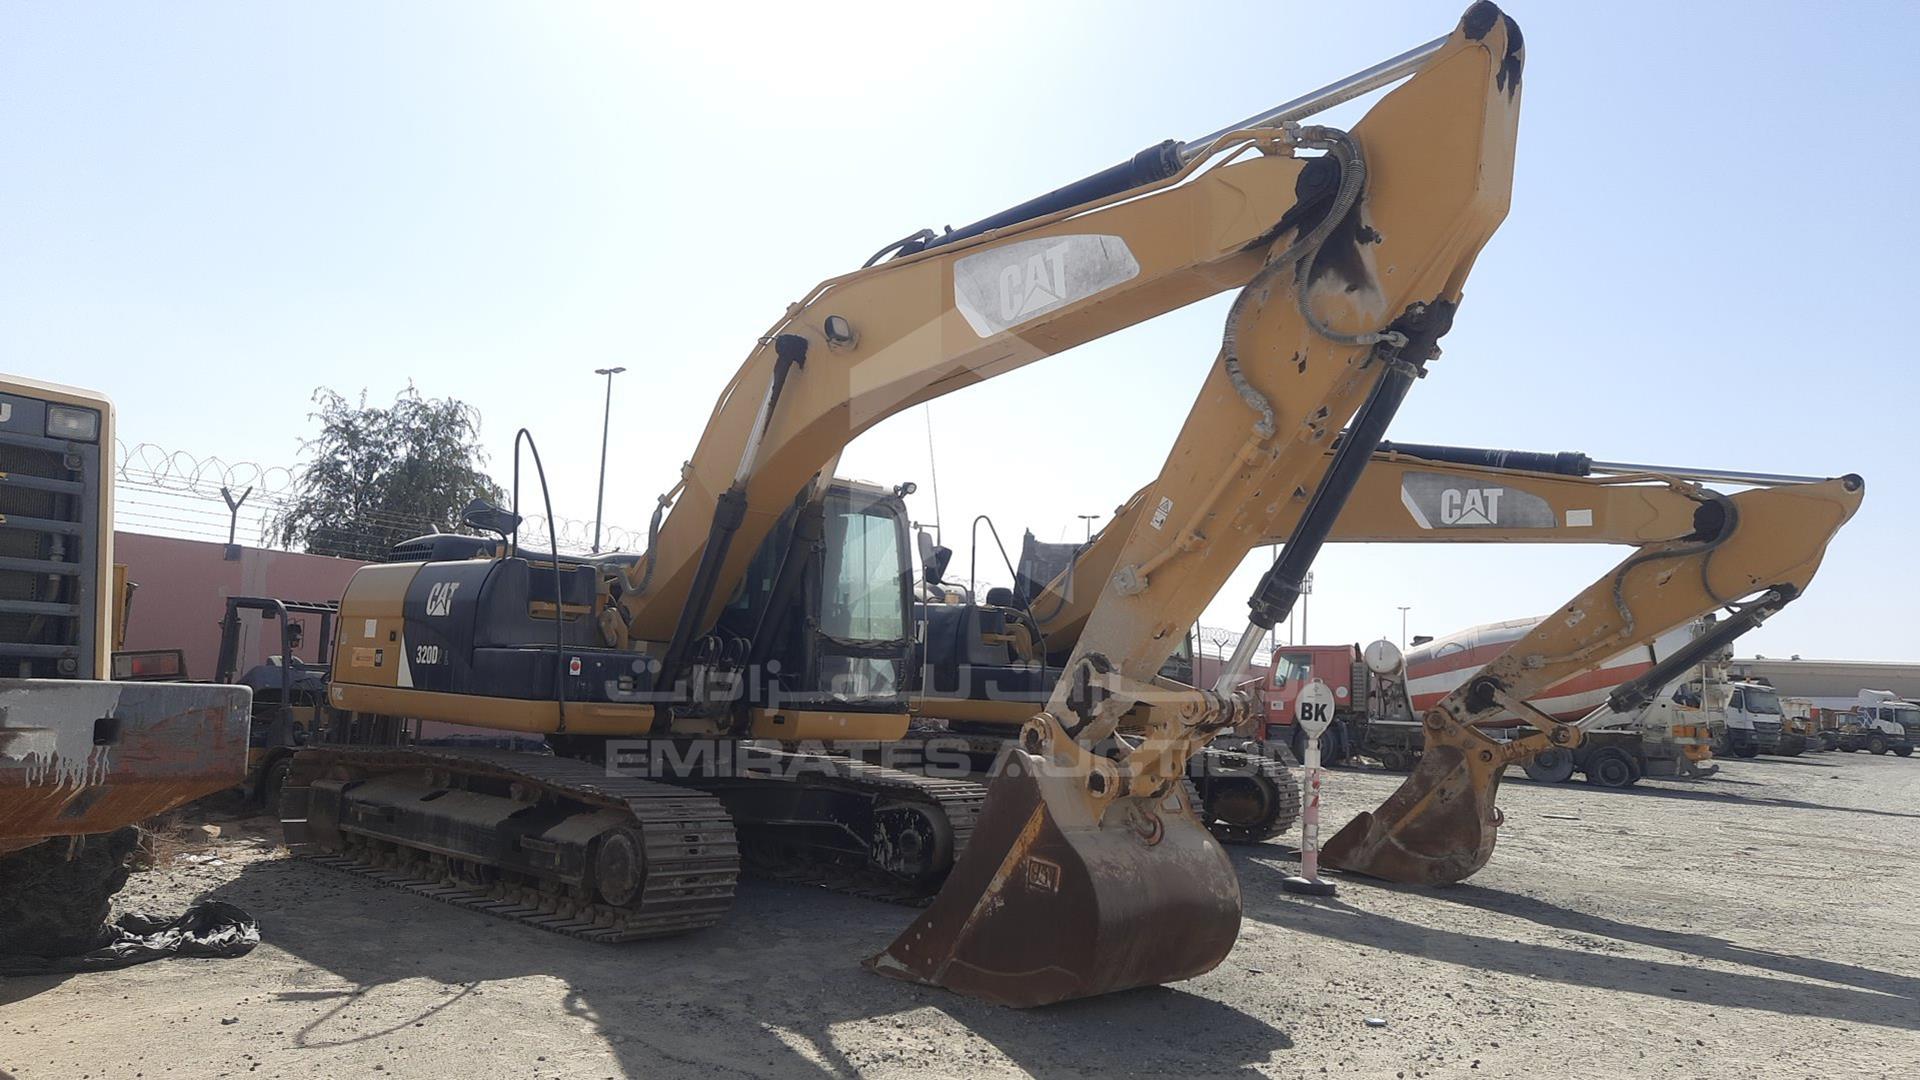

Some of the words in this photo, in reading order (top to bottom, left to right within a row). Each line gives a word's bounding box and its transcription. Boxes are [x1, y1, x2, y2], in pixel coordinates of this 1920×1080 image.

[1000, 241, 1069, 321] CAT
[1441, 488, 1503, 525] CAT
[426, 582, 460, 616] CAT
[1301, 702, 1327, 722] BK
